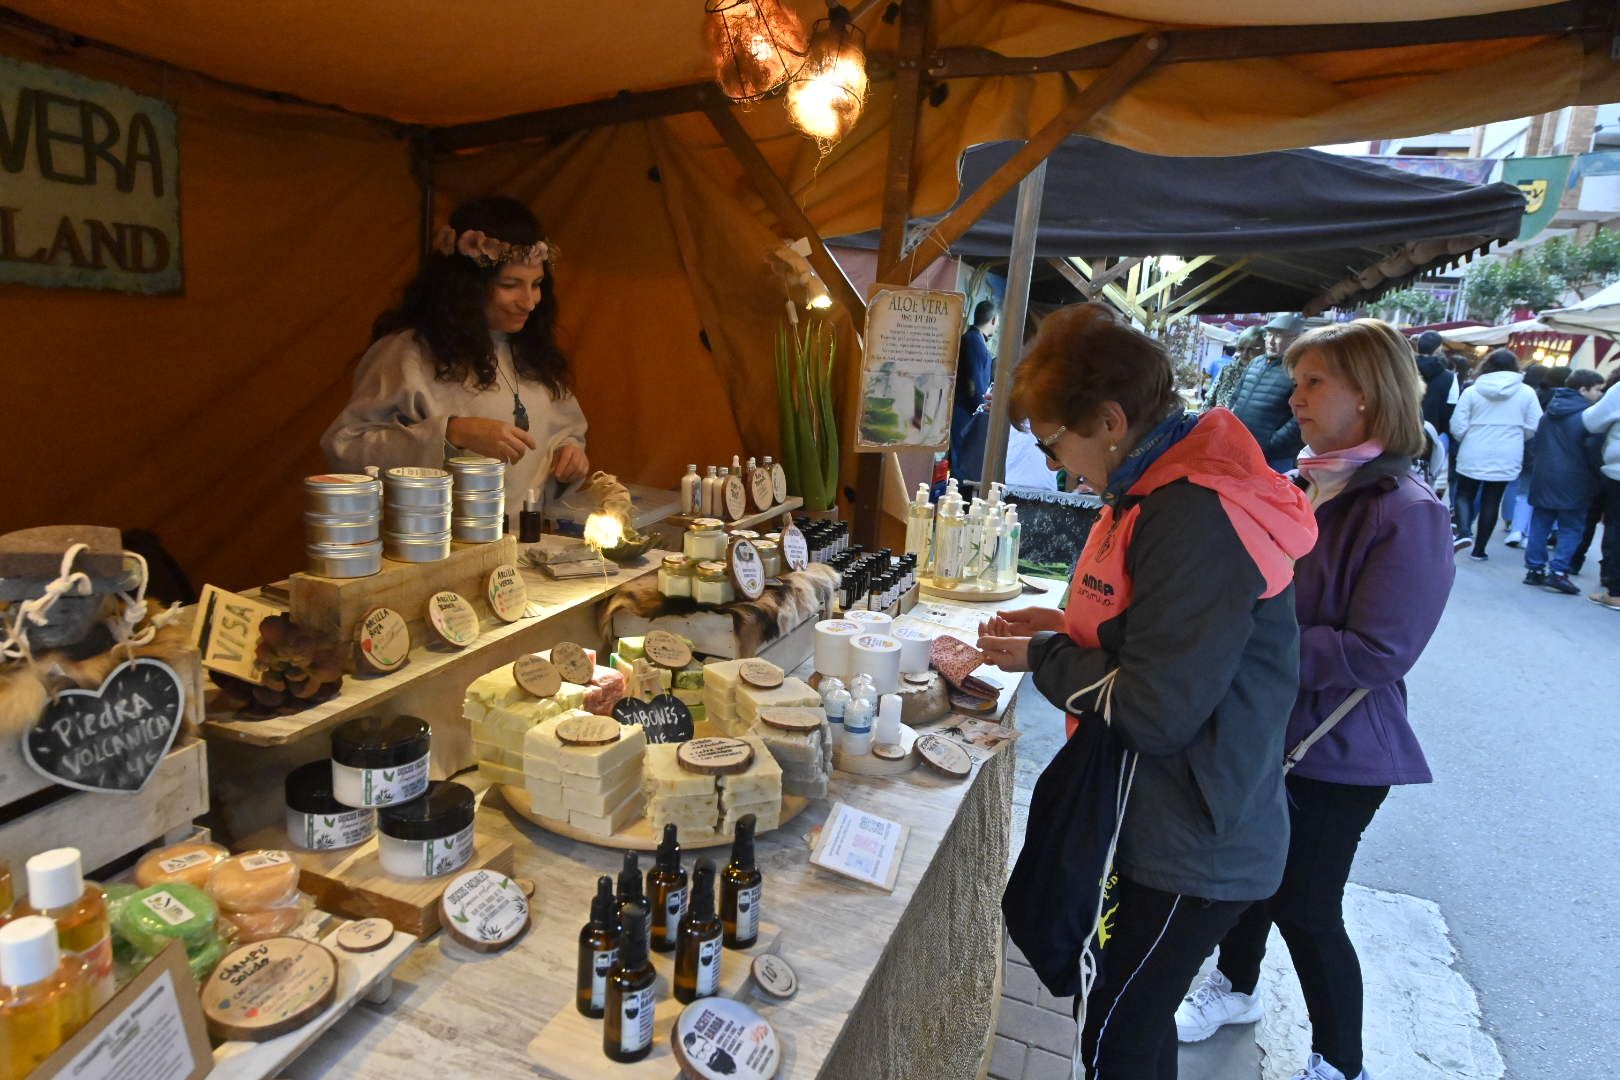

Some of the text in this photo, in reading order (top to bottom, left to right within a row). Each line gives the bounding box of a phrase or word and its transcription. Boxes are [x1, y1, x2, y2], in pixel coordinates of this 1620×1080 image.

[889, 296, 949, 314] ALOE VERA
[212, 603, 254, 662] VISA
